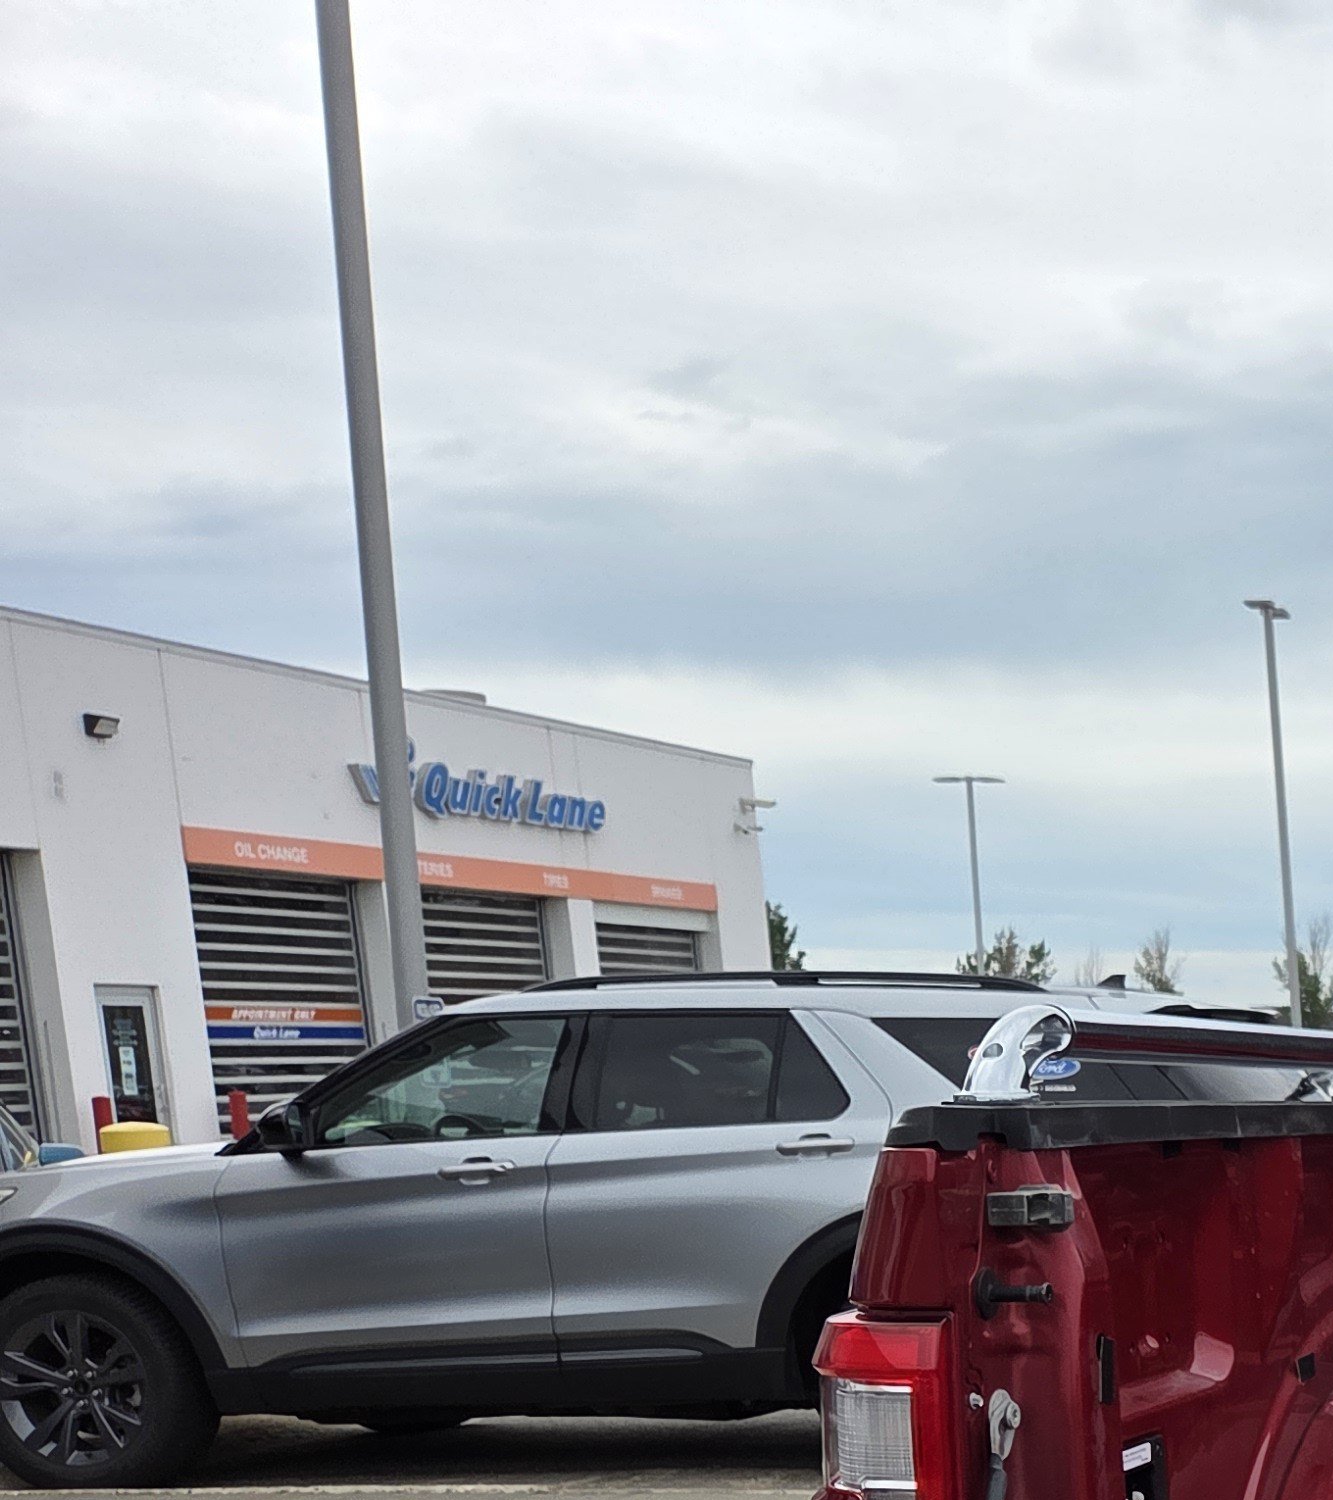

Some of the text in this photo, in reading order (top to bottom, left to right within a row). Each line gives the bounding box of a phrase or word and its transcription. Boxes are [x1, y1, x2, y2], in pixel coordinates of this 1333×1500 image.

[418, 762, 607, 832] Quick Lane
[234, 841, 308, 864] OIL CHANGE
